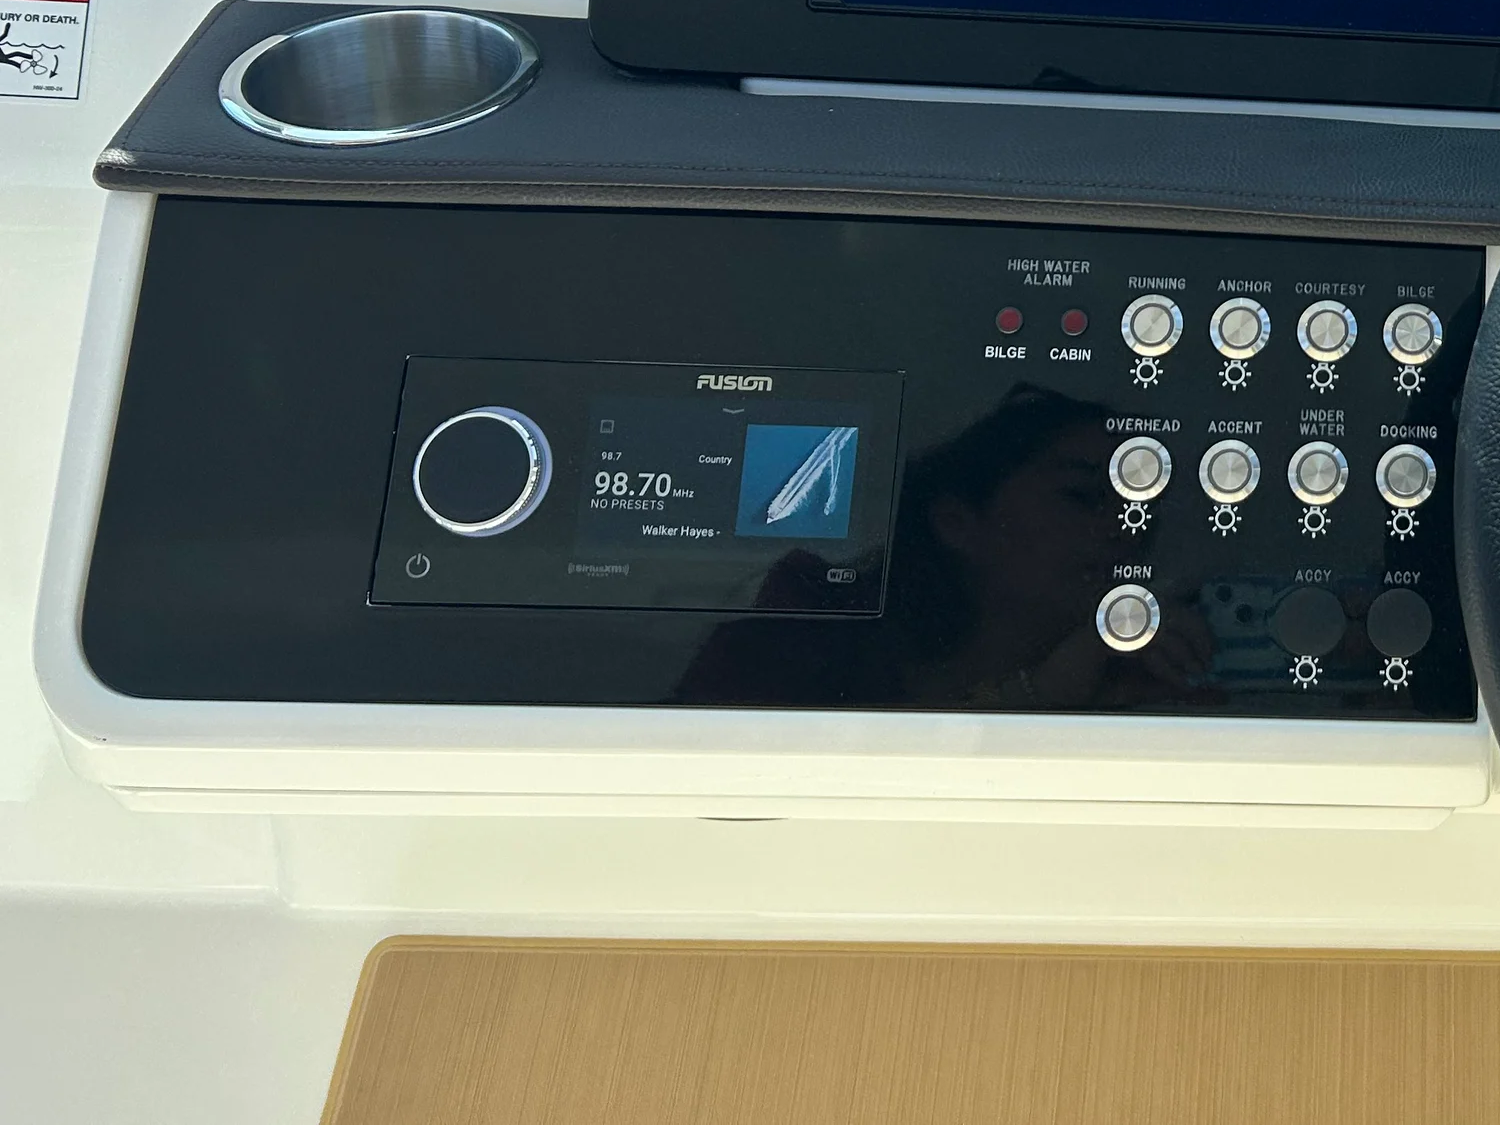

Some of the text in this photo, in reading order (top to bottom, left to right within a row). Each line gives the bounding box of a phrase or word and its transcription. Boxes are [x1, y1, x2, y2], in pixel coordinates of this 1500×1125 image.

[24, 14, 79, 25] OR DEATH.
[1007, 260, 1090, 274] HIGH WATER
[1024, 274, 1073, 286] ALARM
[1128, 277, 1186, 291] RUNNING
[1217, 280, 1272, 293] ANCHOR
[1295, 282, 1365, 296] COURTESY
[1397, 285, 1435, 298] BILGE
[984, 346, 1026, 359] BILGE
[1050, 347, 1091, 361] CABIN
[1301, 409, 1345, 423] UNDER
[1106, 418, 1180, 432] OVERHEAD
[1208, 421, 1263, 434] ACCENT
[1299, 423, 1345, 437] WATER
[1380, 425, 1438, 438] DOCKING
[601, 452, 732, 466] 98.7 Country
[595, 471, 694, 498] 98.70 MHz
[590, 499, 665, 510] NO PRESETS
[642, 525, 714, 539] Walker Hayes
[1113, 565, 1152, 579] HORN
[1294, 569, 1332, 583] ACCY
[1384, 571, 1421, 585] ACCY
